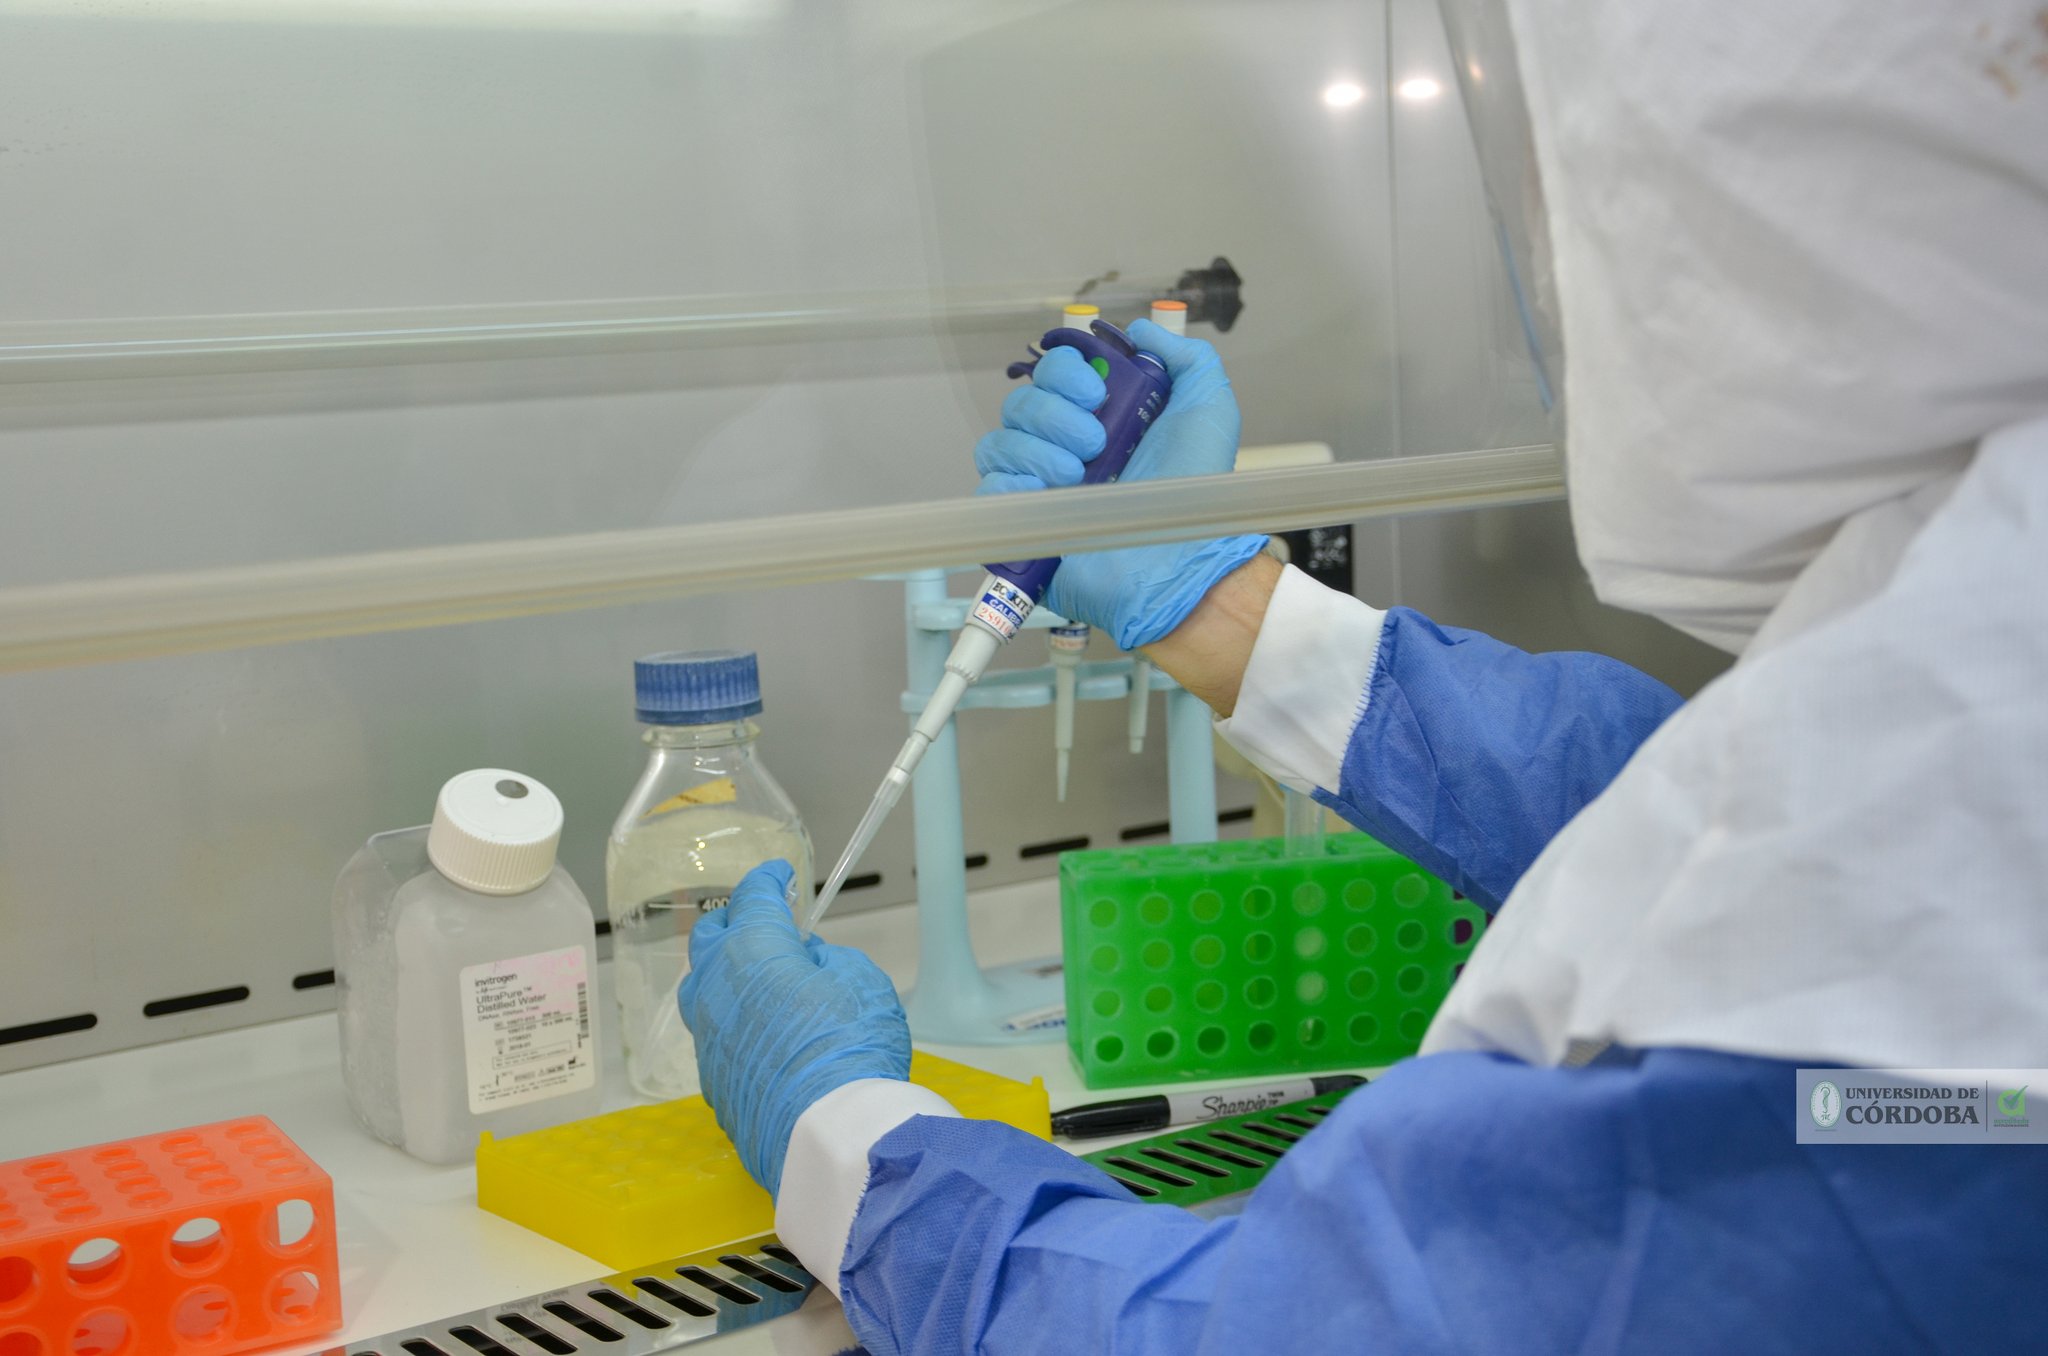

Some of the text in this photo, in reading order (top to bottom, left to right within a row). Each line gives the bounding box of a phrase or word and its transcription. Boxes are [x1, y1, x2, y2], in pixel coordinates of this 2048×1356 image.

[702, 897, 730, 912] 400
[475, 974, 518, 987] invitrogen
[477, 994, 546, 1014] Distilled Water
[1196, 1095, 1266, 1119] Sharpie
